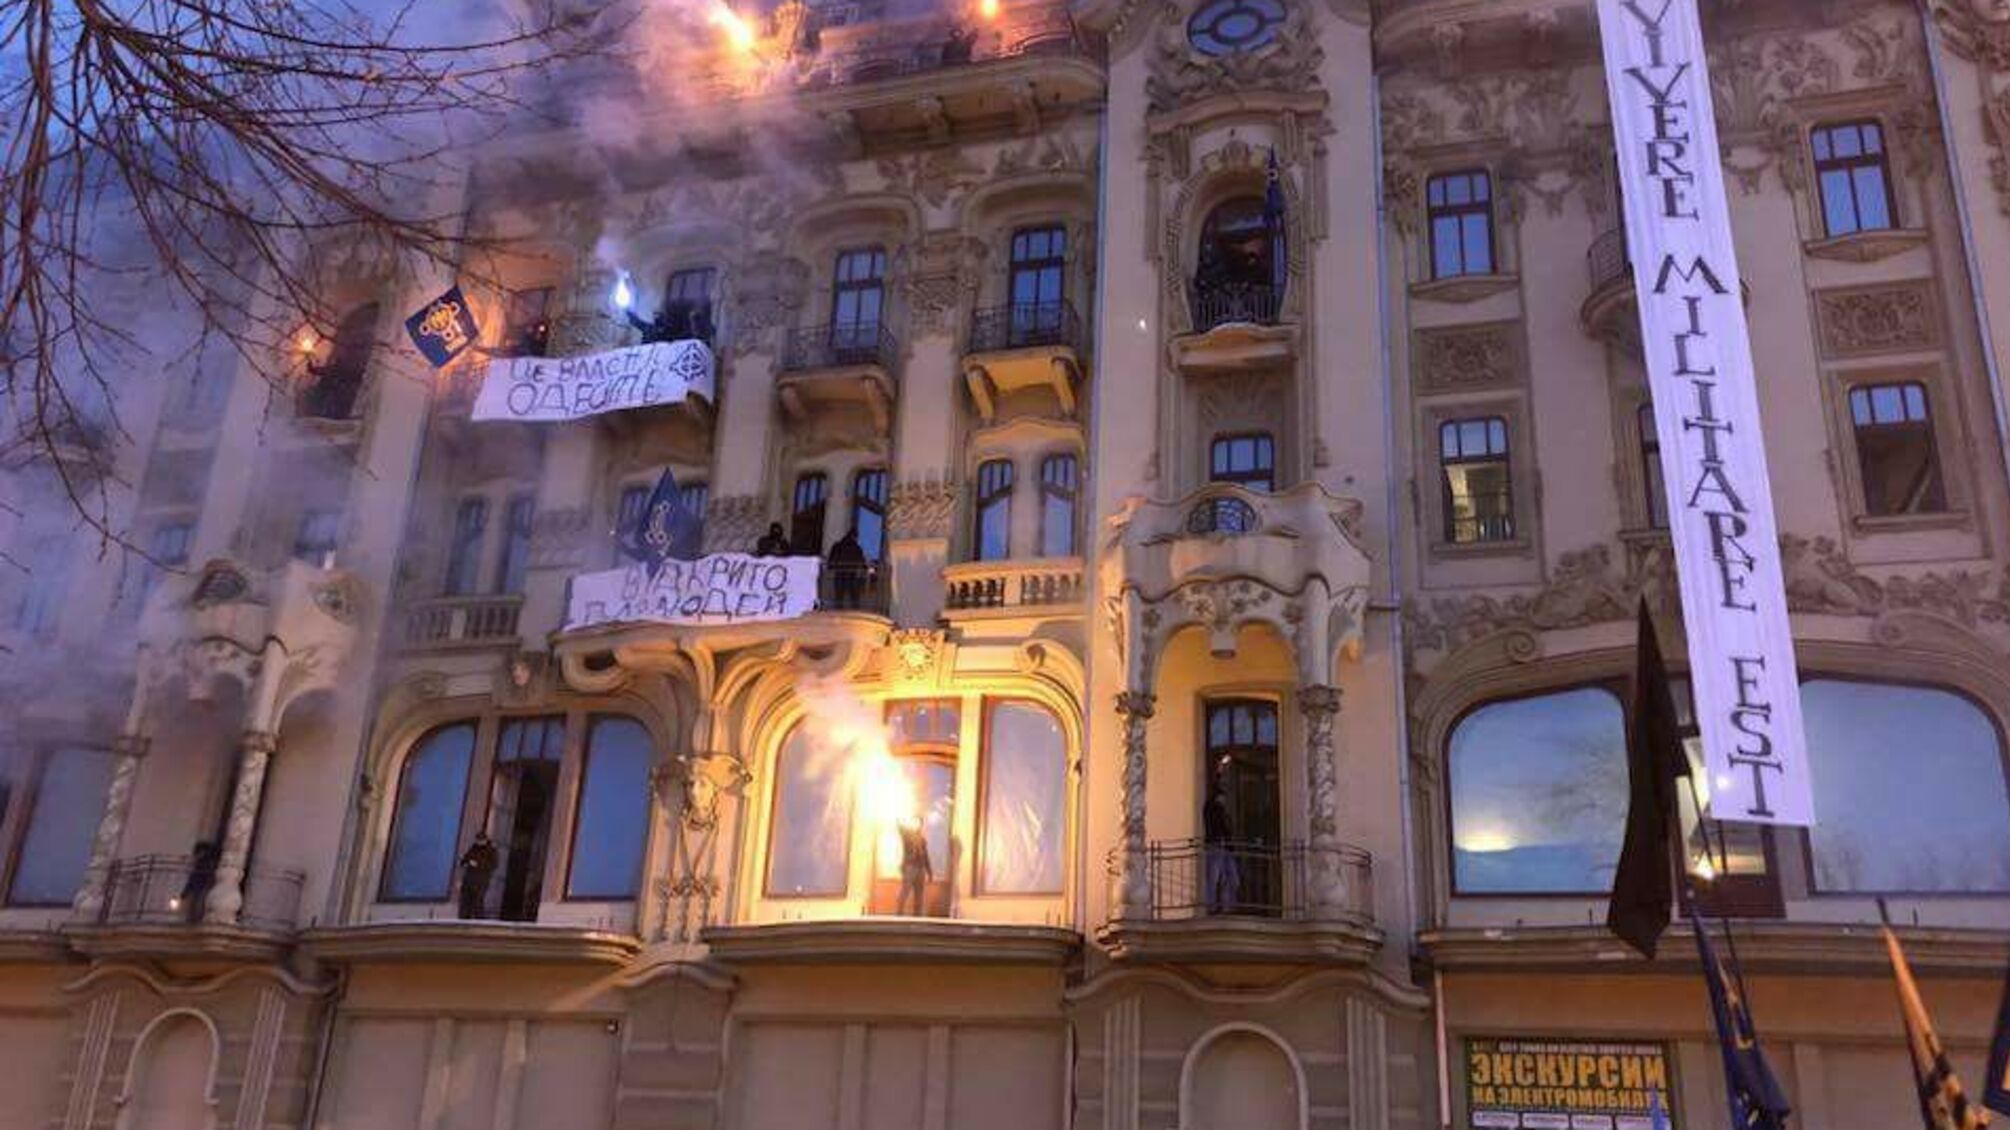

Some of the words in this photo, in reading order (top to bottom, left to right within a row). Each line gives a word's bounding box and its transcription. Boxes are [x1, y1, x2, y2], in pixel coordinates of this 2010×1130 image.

[1653, 254, 1757, 611] MILITARE
[1728, 655, 1783, 817] EST
[1471, 1053, 1666, 1089] ЭКСКУРСИИ
